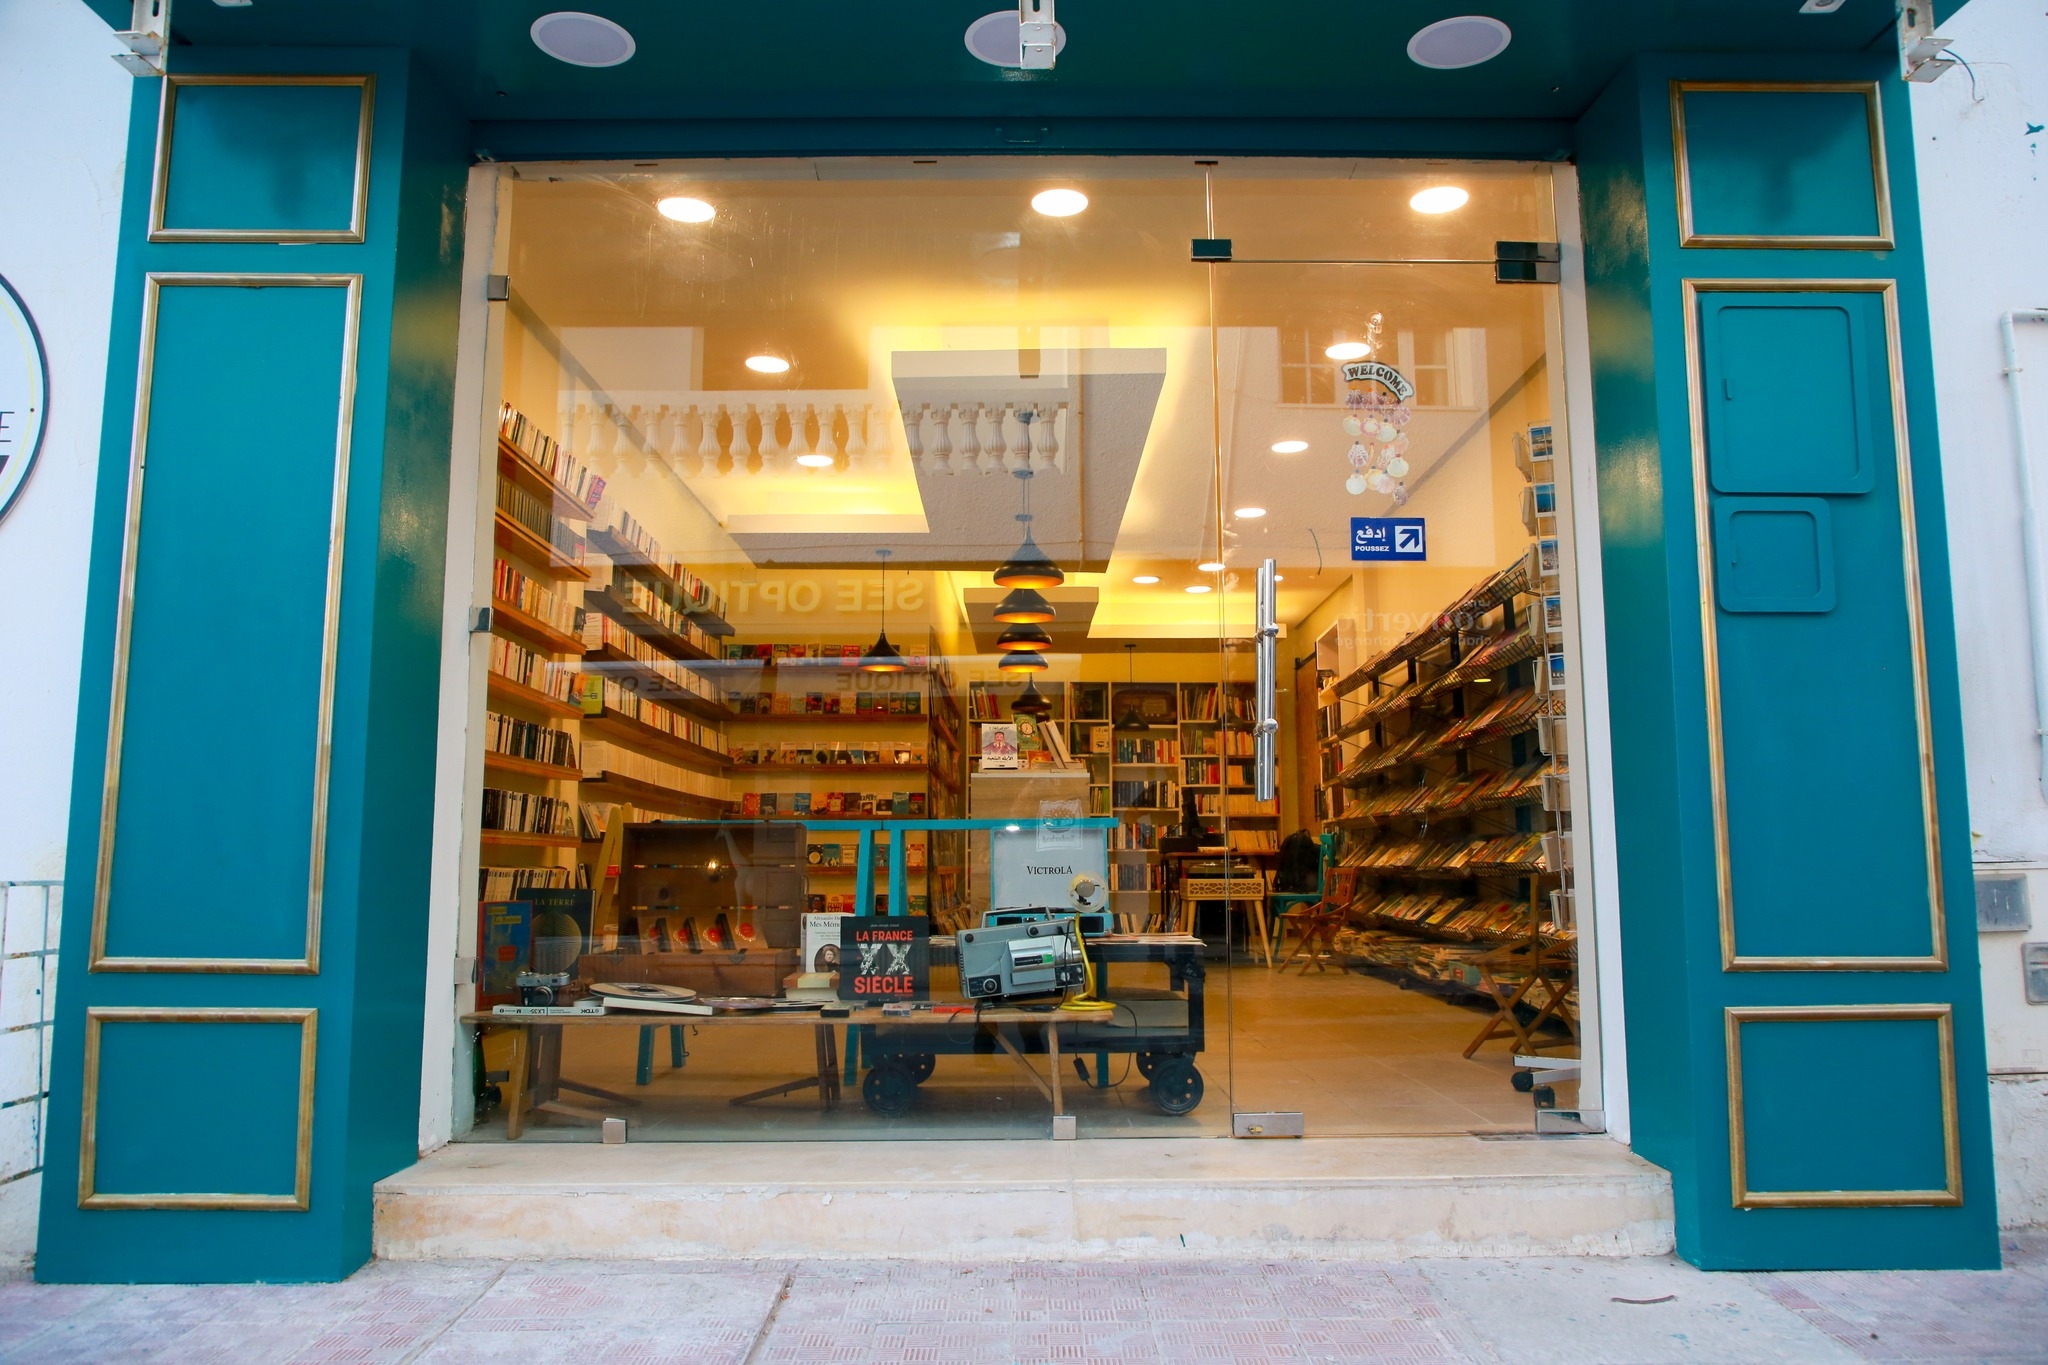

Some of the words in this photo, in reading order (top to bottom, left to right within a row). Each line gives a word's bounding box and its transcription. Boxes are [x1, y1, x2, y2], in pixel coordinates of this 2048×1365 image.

[1347, 364, 1408, 396] WELCOME
[1355, 525, 1386, 544] إدفع
[1026, 865, 1073, 875] VICTROLA
[549, 898, 575, 906] TERRE
[856, 930, 870, 942] LA
[872, 930, 913, 941] FRANCE
[854, 975, 913, 993] SIÈCLE
